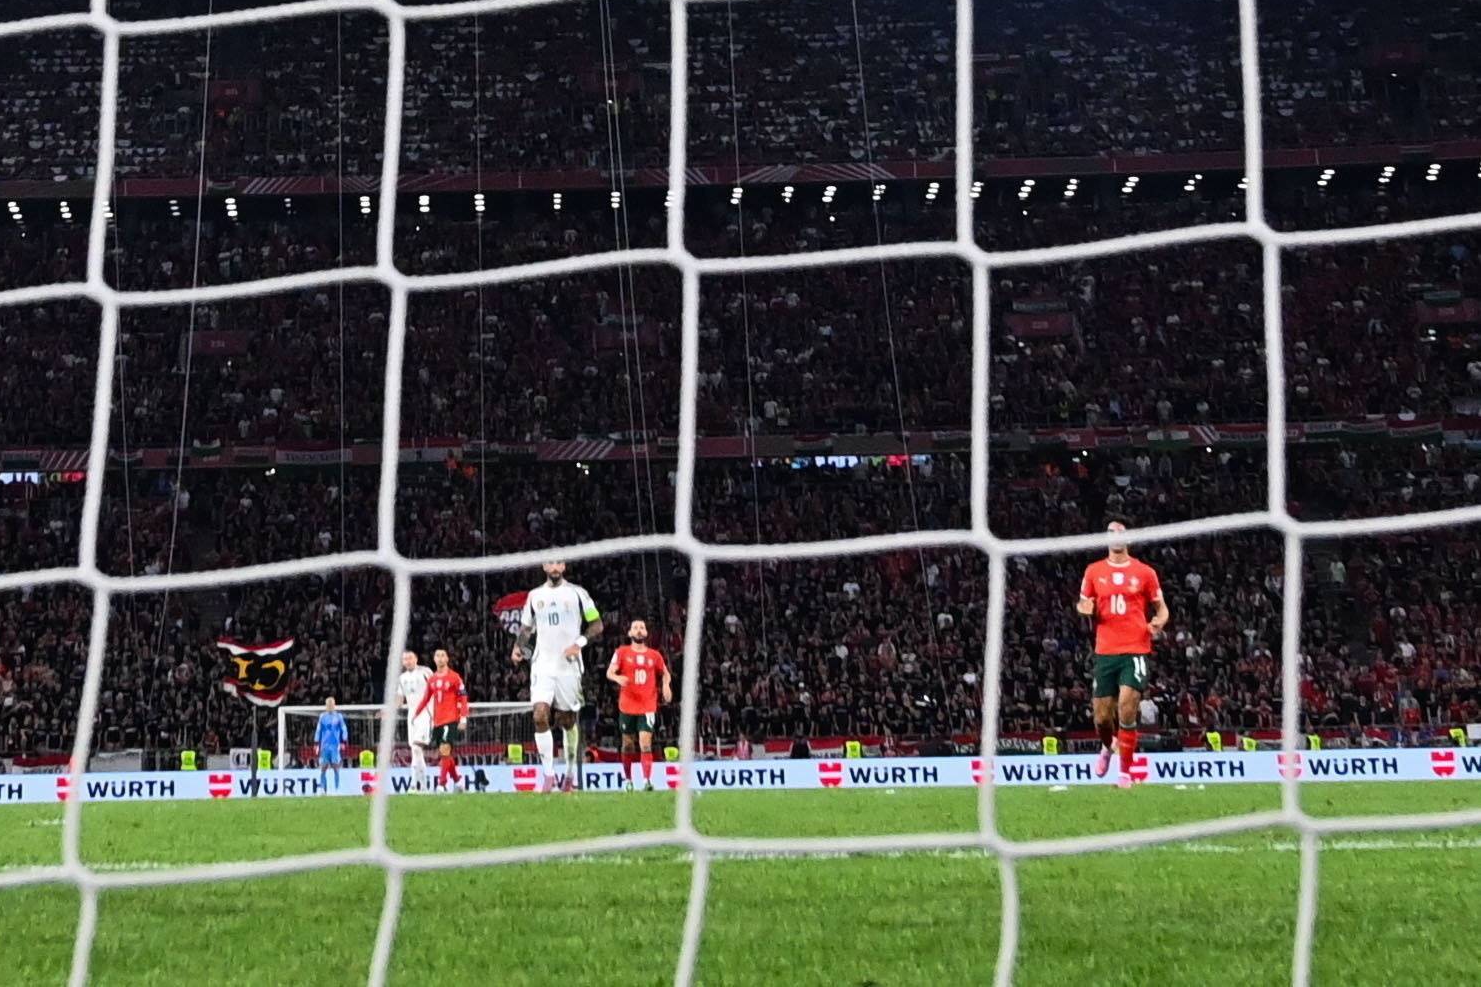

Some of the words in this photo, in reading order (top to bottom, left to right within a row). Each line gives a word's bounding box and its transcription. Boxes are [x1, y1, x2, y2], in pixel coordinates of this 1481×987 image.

[1110, 594, 1127, 615] 16
[548, 612, 560, 626] 10
[634, 669, 647, 685] 10
[849, 766, 938, 784] WÜRTH
[1002, 763, 1092, 781] WÜRTH
[1155, 760, 1245, 778] WÜRTH
[1308, 757, 1399, 775] WÜRTH
[697, 768, 785, 786] WÜRTH
[87, 780, 175, 798] WÜRTH
